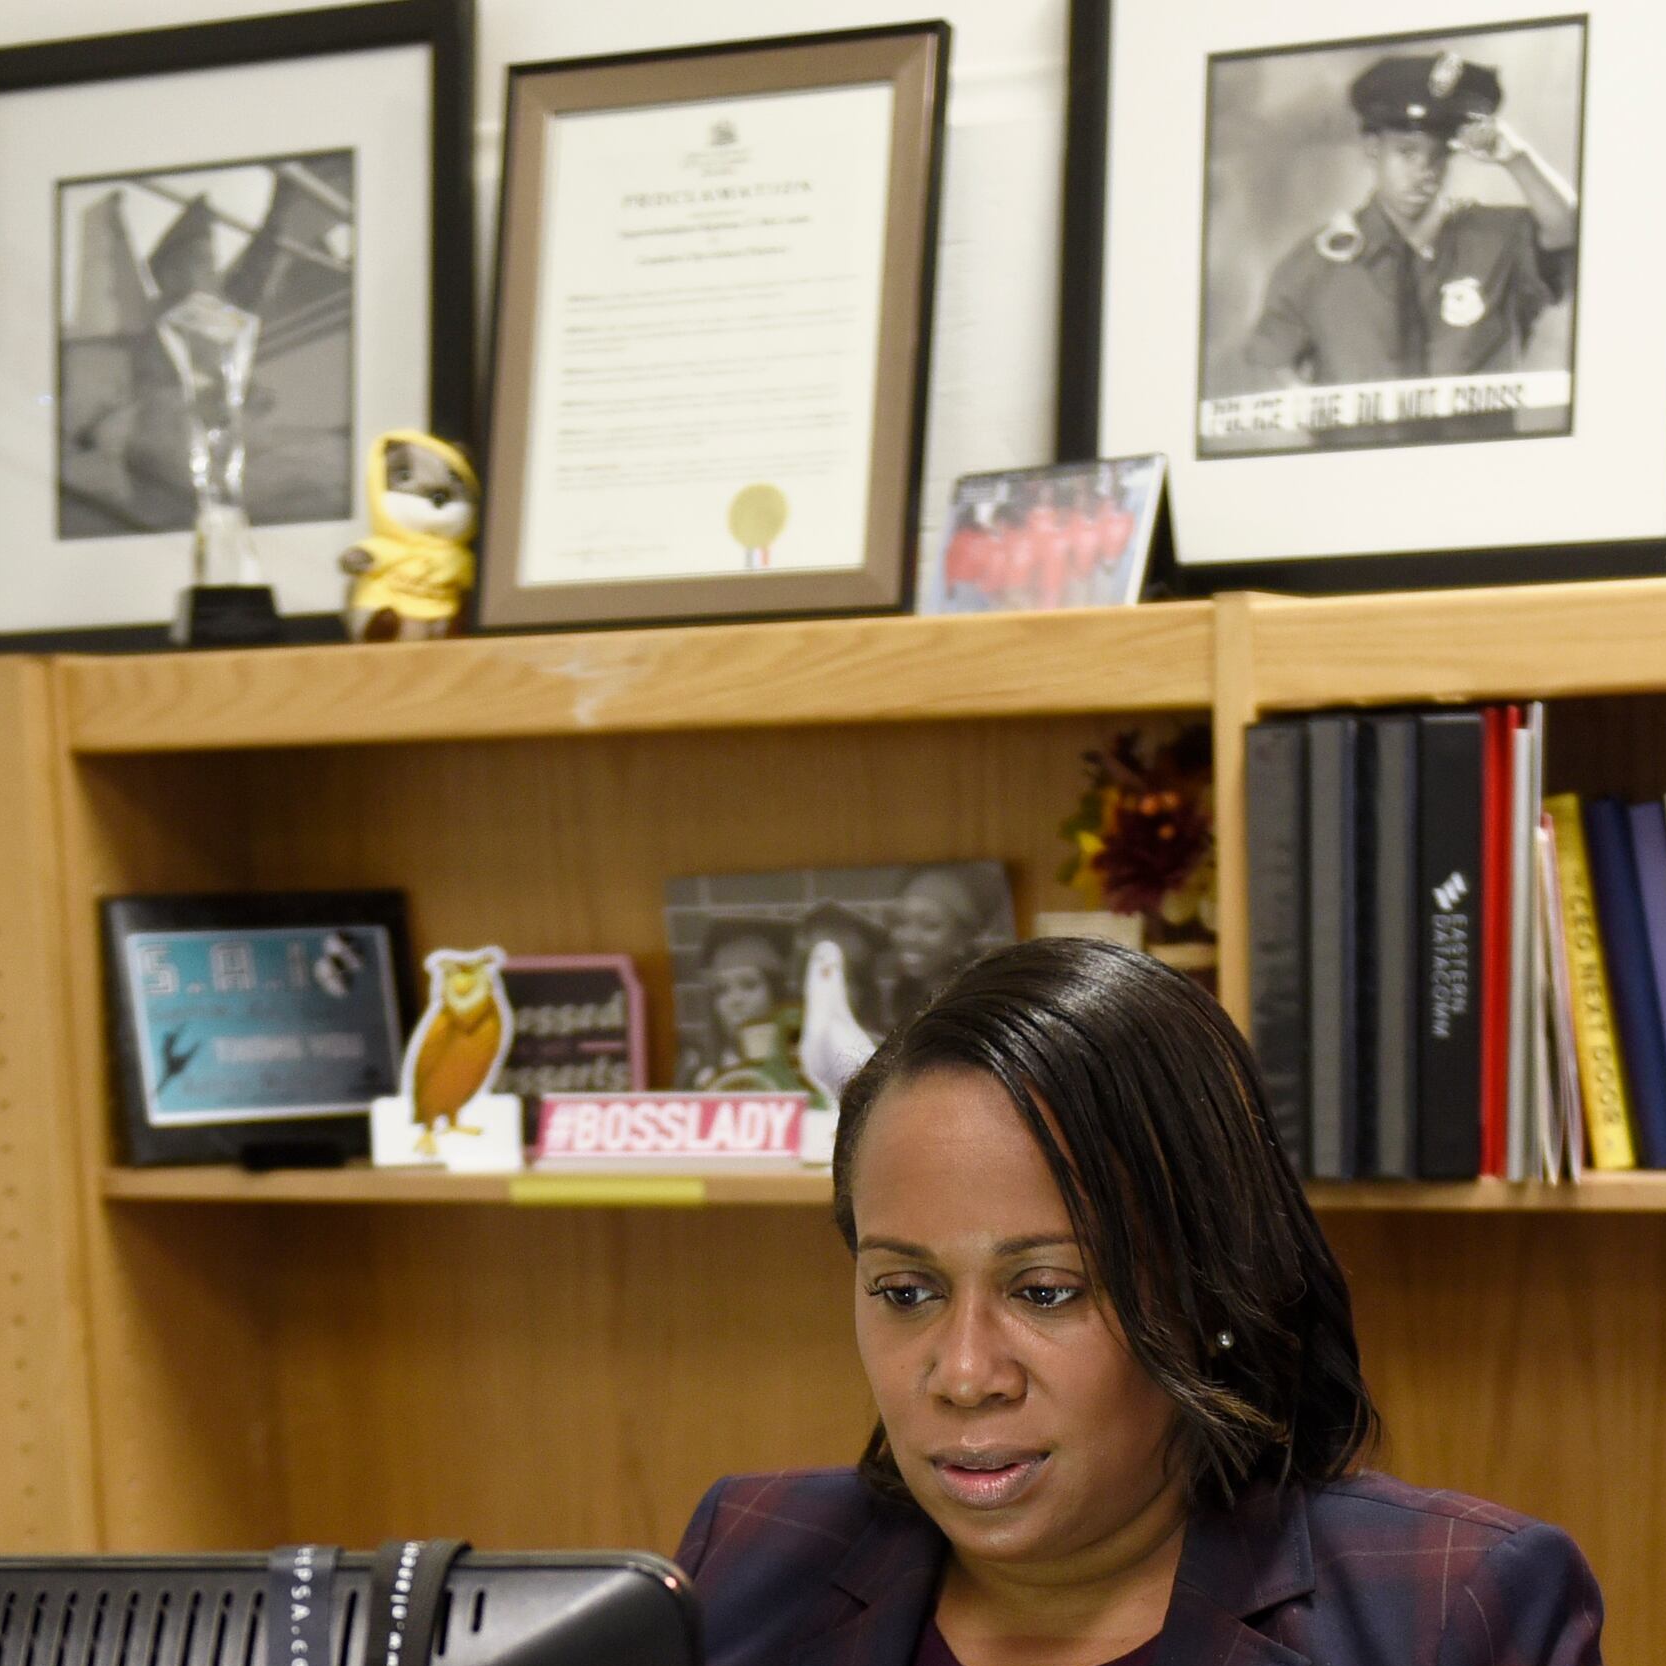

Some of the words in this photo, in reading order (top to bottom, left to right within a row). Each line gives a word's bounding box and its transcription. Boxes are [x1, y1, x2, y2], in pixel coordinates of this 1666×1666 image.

[1430, 913, 1451, 1040] DATACOMM
[1450, 913, 1468, 1015] EASTERN
[1580, 962, 1609, 1034] NEXT
[1592, 1045, 1621, 1125] DOOR
[544, 1101, 798, 1152] #BOSSLADY
